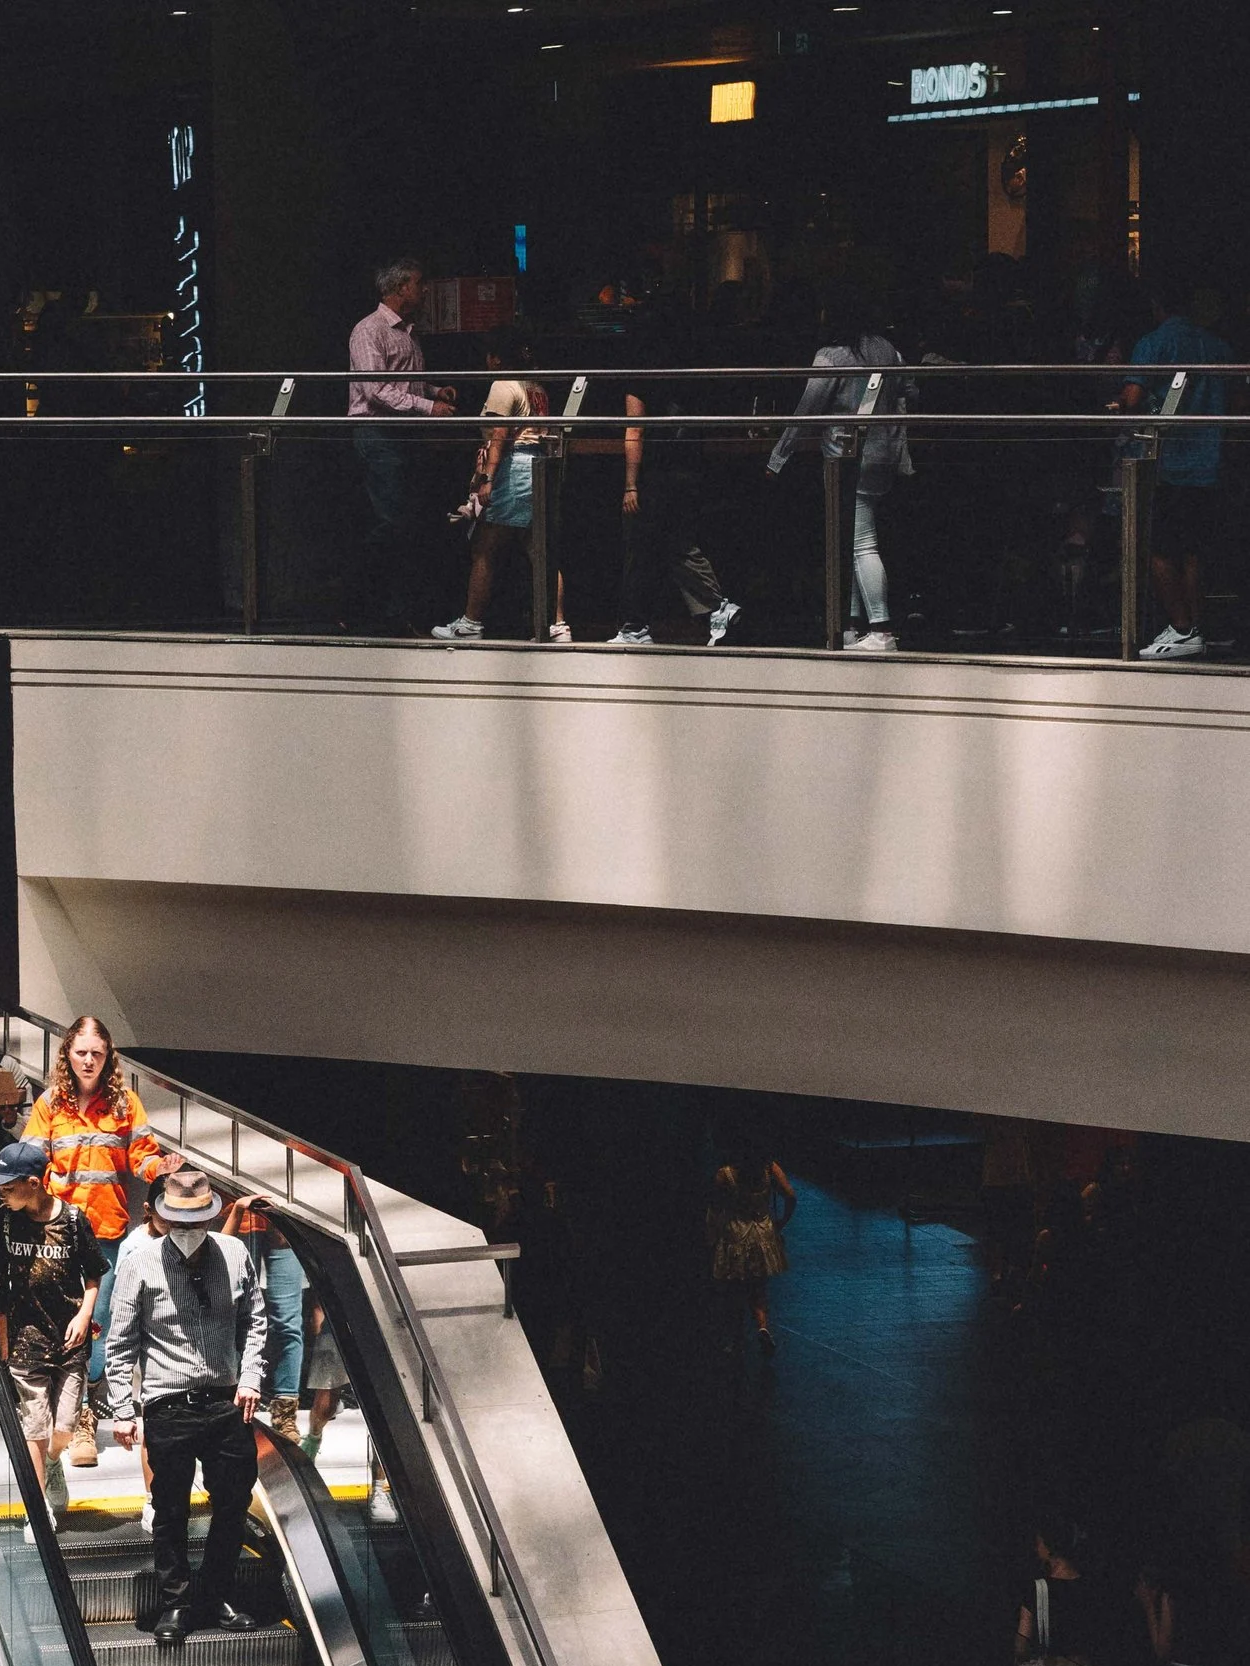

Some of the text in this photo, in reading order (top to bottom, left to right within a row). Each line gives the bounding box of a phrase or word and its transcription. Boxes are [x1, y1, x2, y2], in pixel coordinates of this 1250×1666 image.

[911, 62, 987, 104] BONDS
[10, 1241, 71, 1259] NEW YORK
